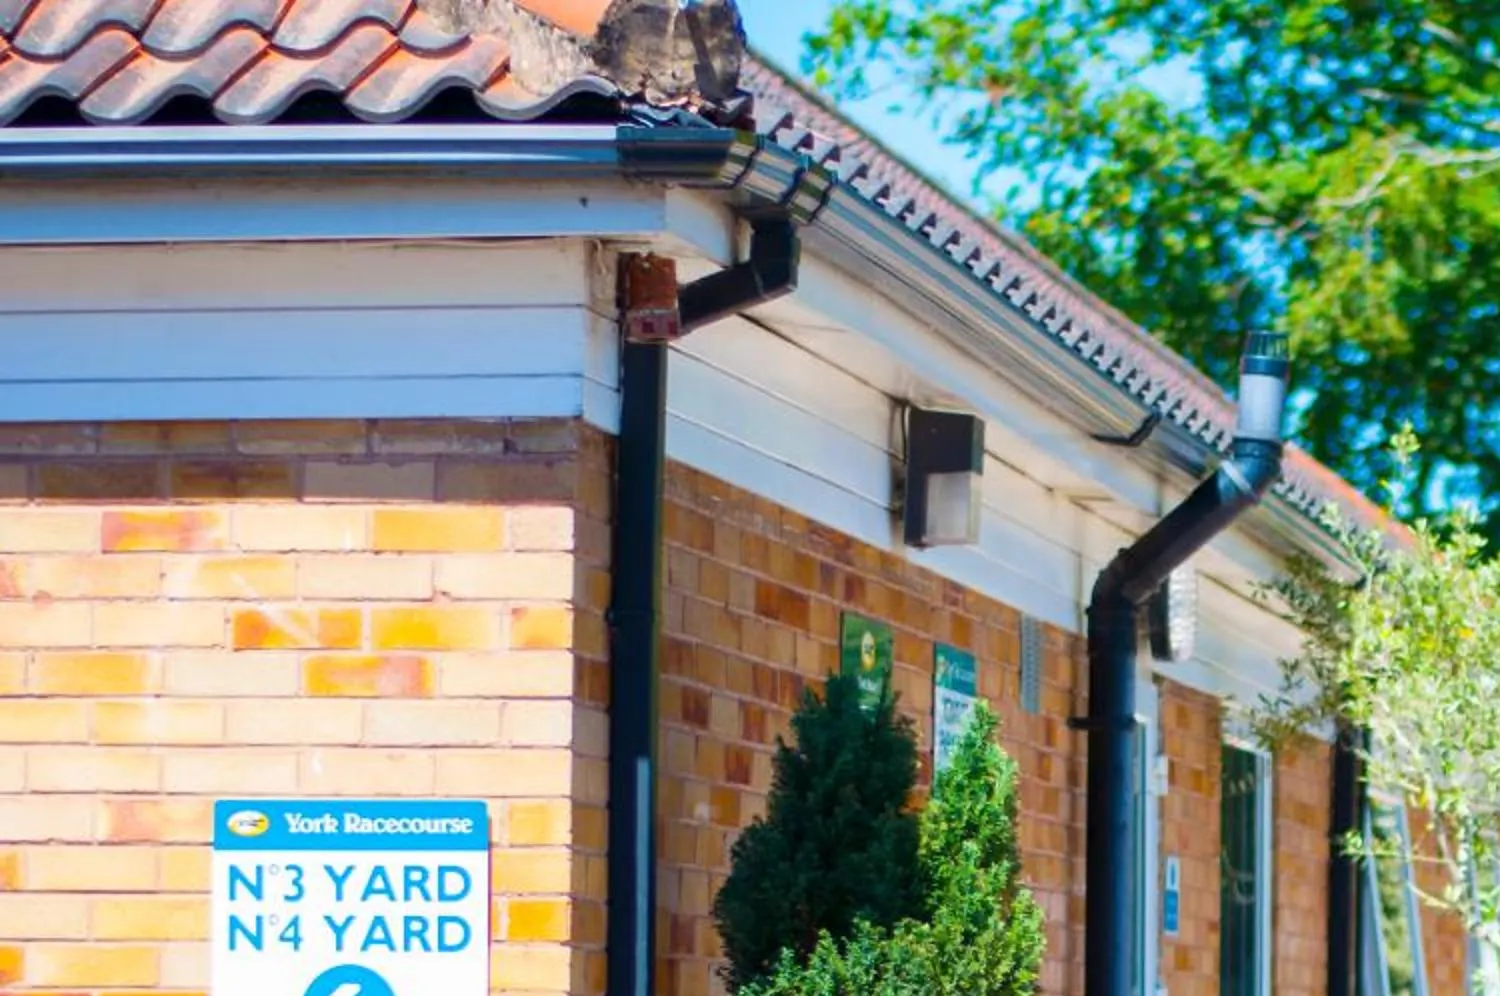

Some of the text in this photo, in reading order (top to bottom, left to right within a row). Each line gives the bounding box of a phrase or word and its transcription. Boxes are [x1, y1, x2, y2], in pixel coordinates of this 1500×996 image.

[284, 812, 473, 834] York Racecourse
[323, 864, 472, 902] YARD
[323, 914, 472, 952] YARD
